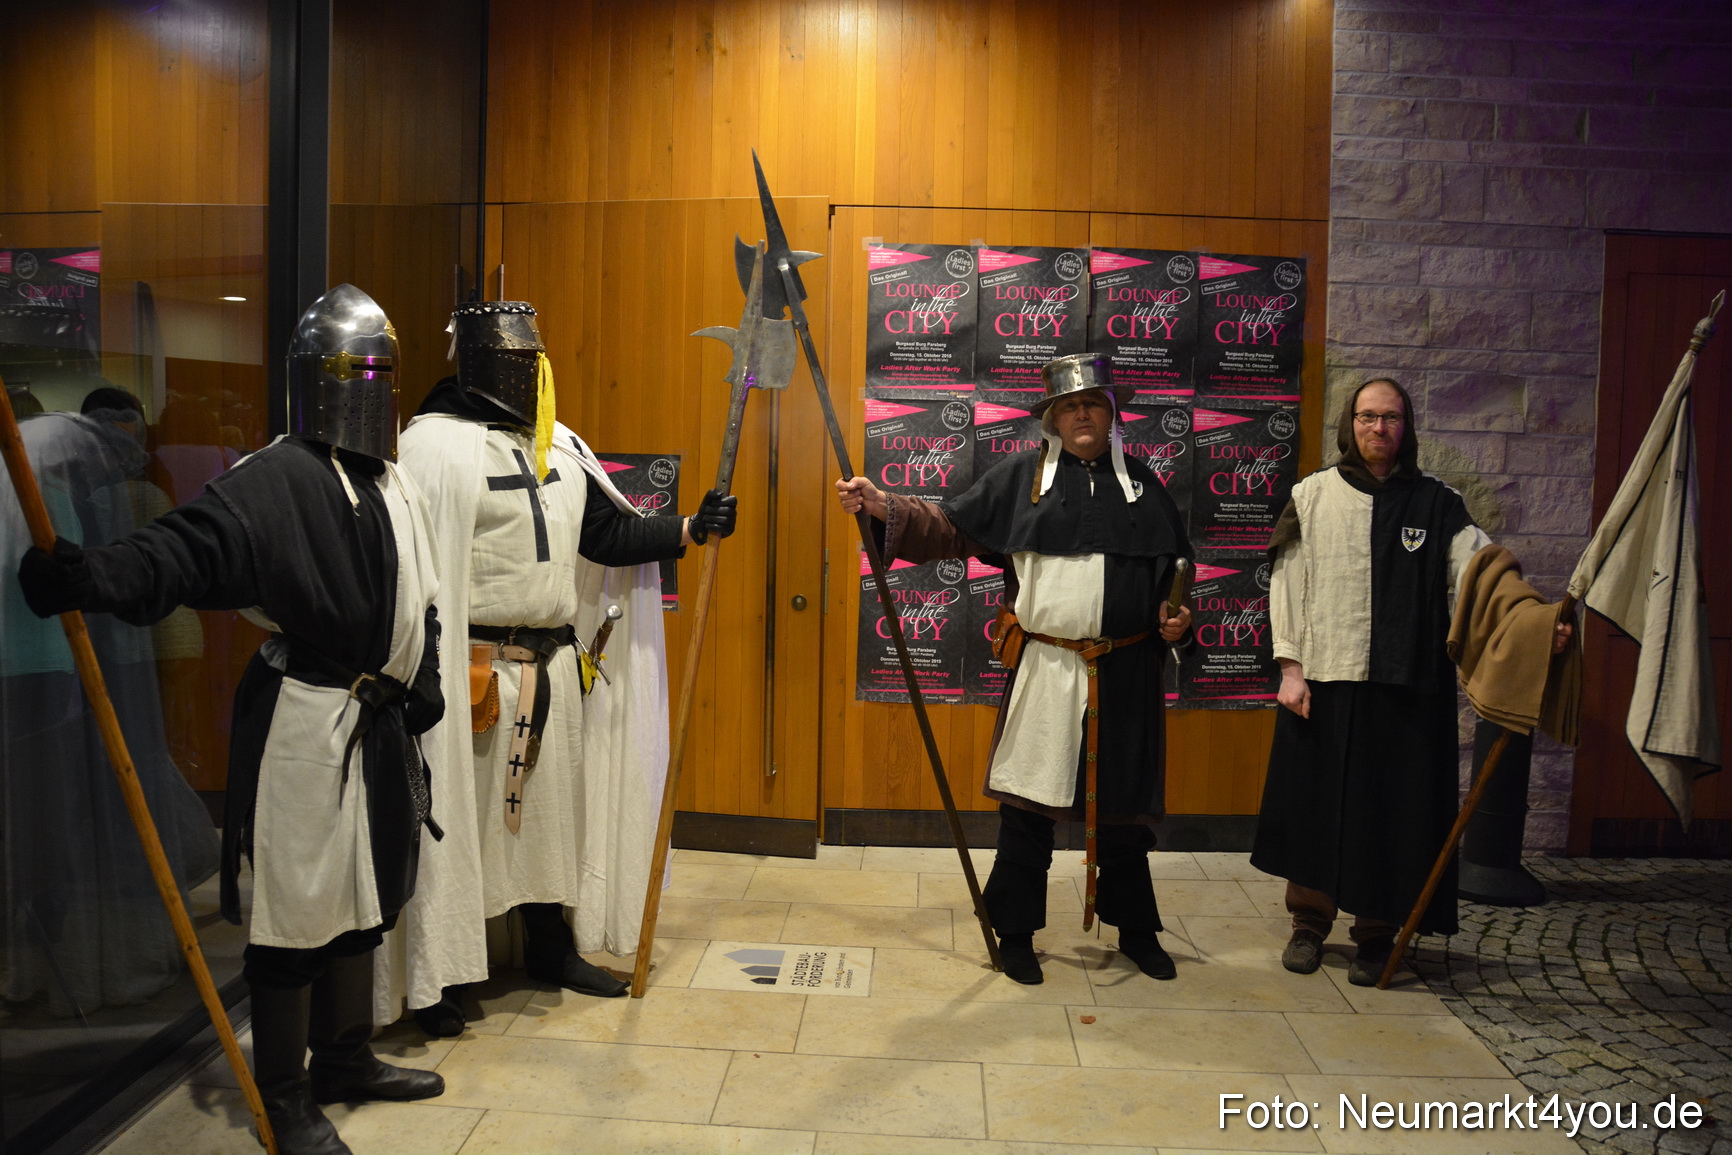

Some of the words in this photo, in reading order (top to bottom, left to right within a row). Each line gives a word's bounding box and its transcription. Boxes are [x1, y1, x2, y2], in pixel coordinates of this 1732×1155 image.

[950, 255, 970, 266] Ladies
[1060, 258, 1080, 268] Ladies
[1172, 261, 1192, 271] Ladies
[952, 262, 966, 271] first
[1061, 265, 1075, 274] first
[1173, 268, 1187, 277] first
[1278, 268, 1298, 278] Ladies
[1280, 274, 1293, 283] first
[885, 283, 960, 298] LOUNGE
[995, 286, 1070, 301] LOUNGE
[1108, 288, 1182, 303] LOUNGE
[1215, 294, 1288, 309] LOUNGE
[884, 310, 958, 334] CITY
[994, 313, 1068, 336] CITY
[1107, 315, 1179, 339] CITY
[1214, 321, 1285, 344] CITY
[946, 408, 967, 418] Ladies
[948, 414, 962, 424] first
[1166, 415, 1186, 425] Ladies
[1273, 417, 1292, 428] Ladies
[1168, 421, 1181, 430] first
[1274, 424, 1287, 433] first
[882, 436, 957, 451] LOUNGE
[991, 439, 1041, 453] LOUN
[1210, 445, 1282, 460] LOUNGE
[653, 465, 672, 475] Ladies
[881, 463, 954, 487] CITY
[655, 472, 667, 480] first
[1209, 472, 1280, 495] CITY
[941, 562, 962, 572] Ladies
[943, 569, 956, 578] first
[1198, 598, 1270, 611] LOUNGE
[1197, 624, 1267, 646] CITY
[790, 952, 811, 986] STÄDTEBAU-
[806, 952, 827, 988] FÖRDERUNG
